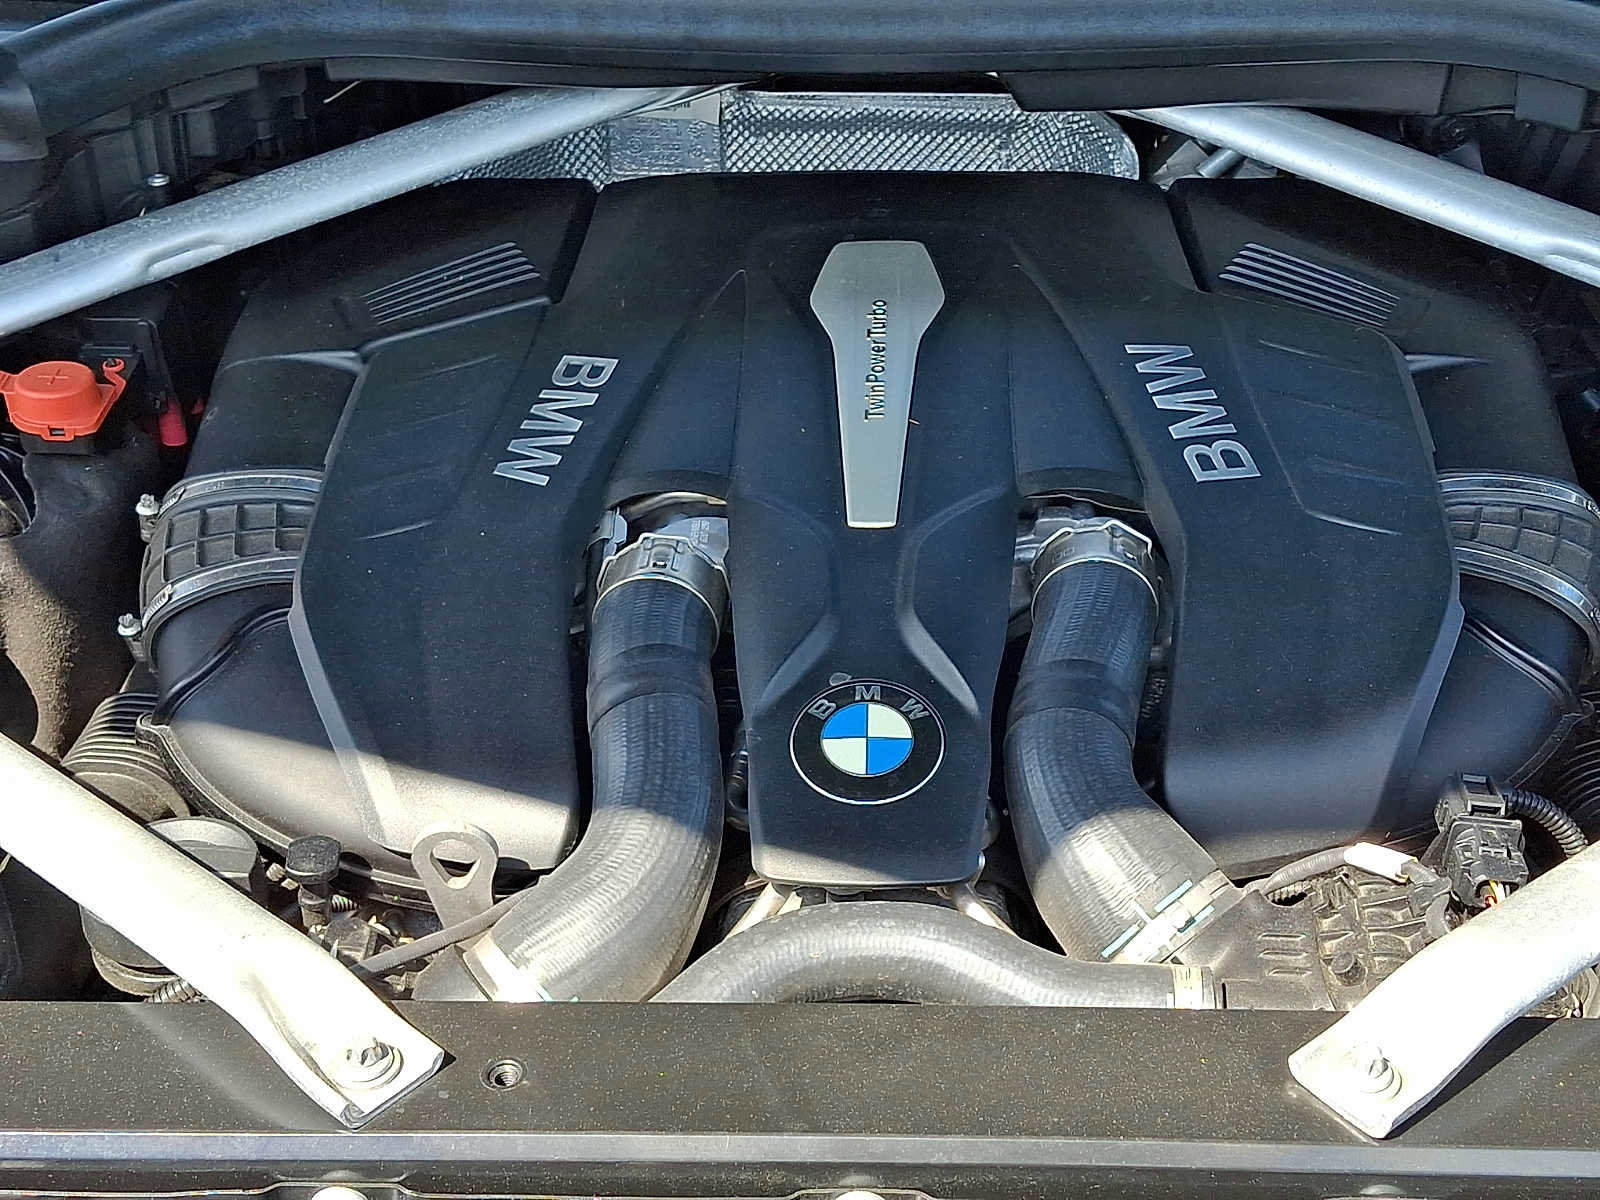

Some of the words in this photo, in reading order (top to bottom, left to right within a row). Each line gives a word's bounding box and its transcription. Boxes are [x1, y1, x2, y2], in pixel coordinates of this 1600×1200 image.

[493, 354, 620, 487] BMW
[1124, 343, 1263, 482] BMW
[807, 685, 931, 720] BMW
